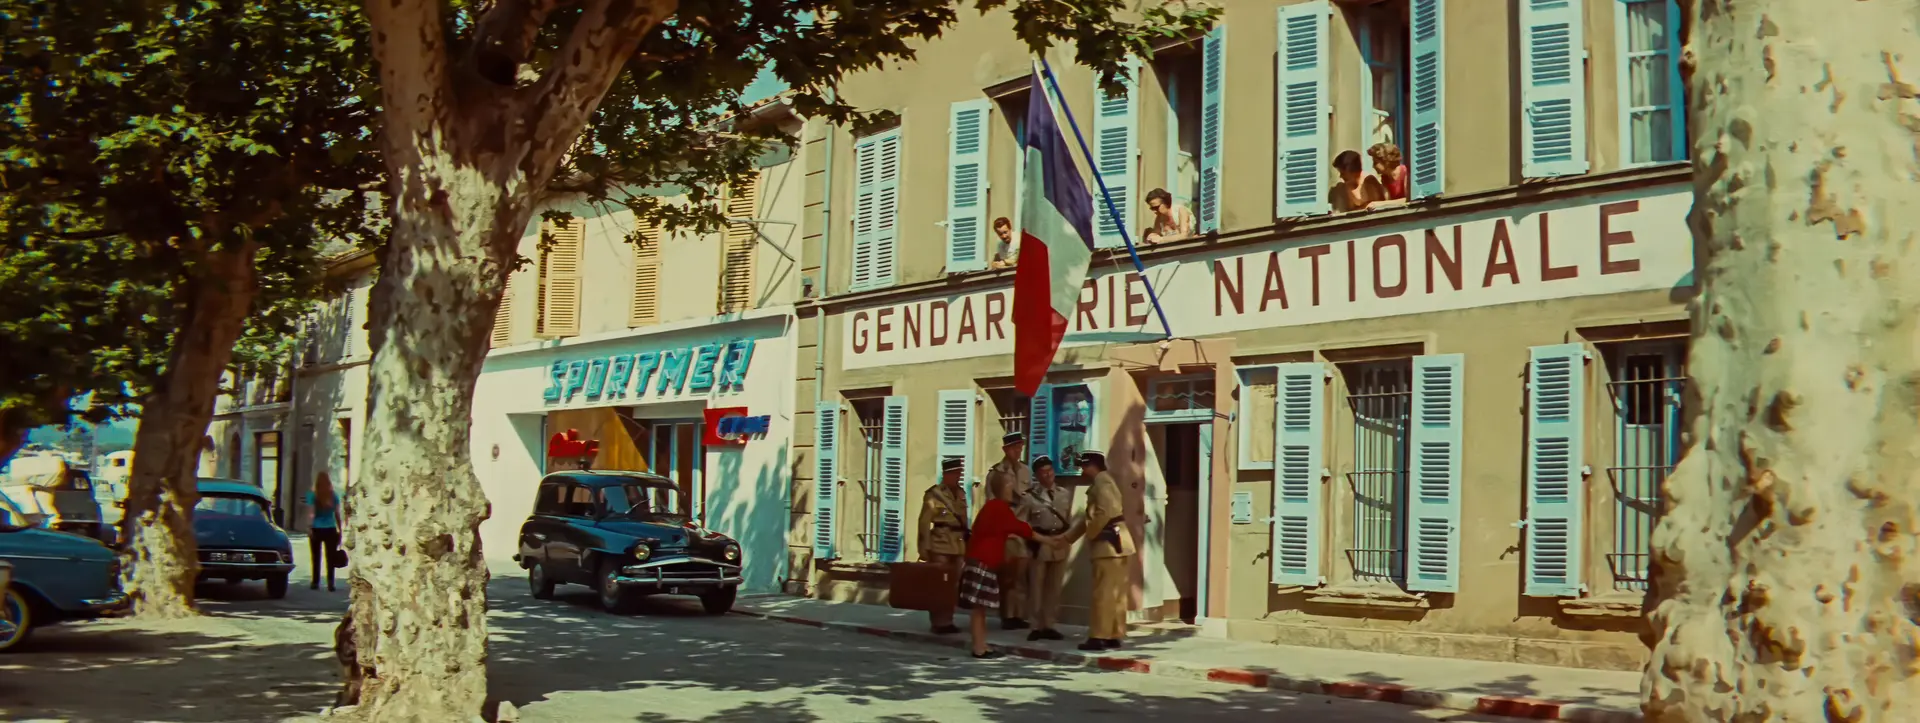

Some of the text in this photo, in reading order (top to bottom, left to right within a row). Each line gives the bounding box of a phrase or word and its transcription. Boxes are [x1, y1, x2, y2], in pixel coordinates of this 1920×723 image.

[853, 200, 1640, 354] GENDARRIE NATIONALE
[544, 338, 754, 401] SPORTMER
